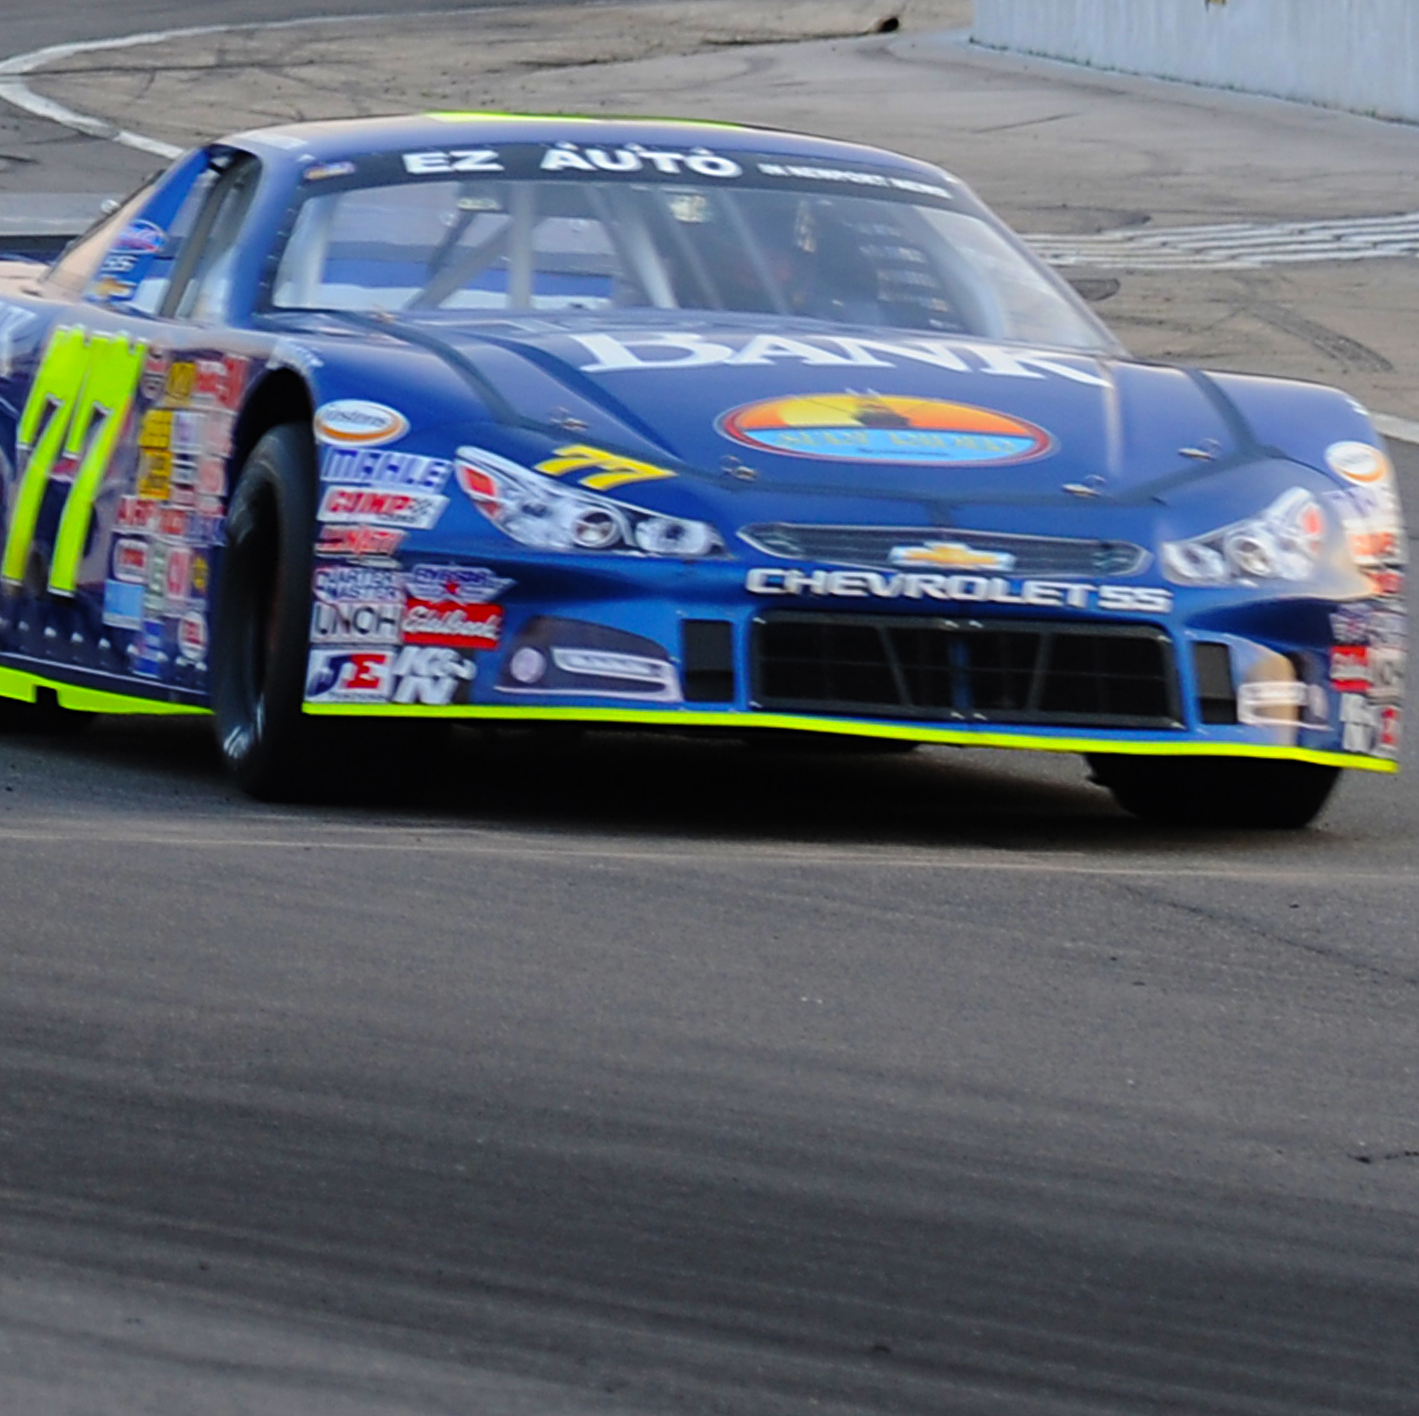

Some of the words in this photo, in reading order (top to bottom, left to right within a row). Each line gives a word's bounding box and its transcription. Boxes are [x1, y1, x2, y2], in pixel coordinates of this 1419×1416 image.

[404, 150, 503, 174] EZ
[541, 148, 743, 178] AUTO
[569, 331, 1114, 388] BANK
[2, 326, 148, 597] 77
[534, 443, 678, 490] 77
[329, 490, 412, 514] COMP
[744, 568, 1095, 610] CHEVROLET
[1099, 584, 1172, 613] SS
[315, 605, 397, 636] UNOH
[309, 652, 386, 696] JE
